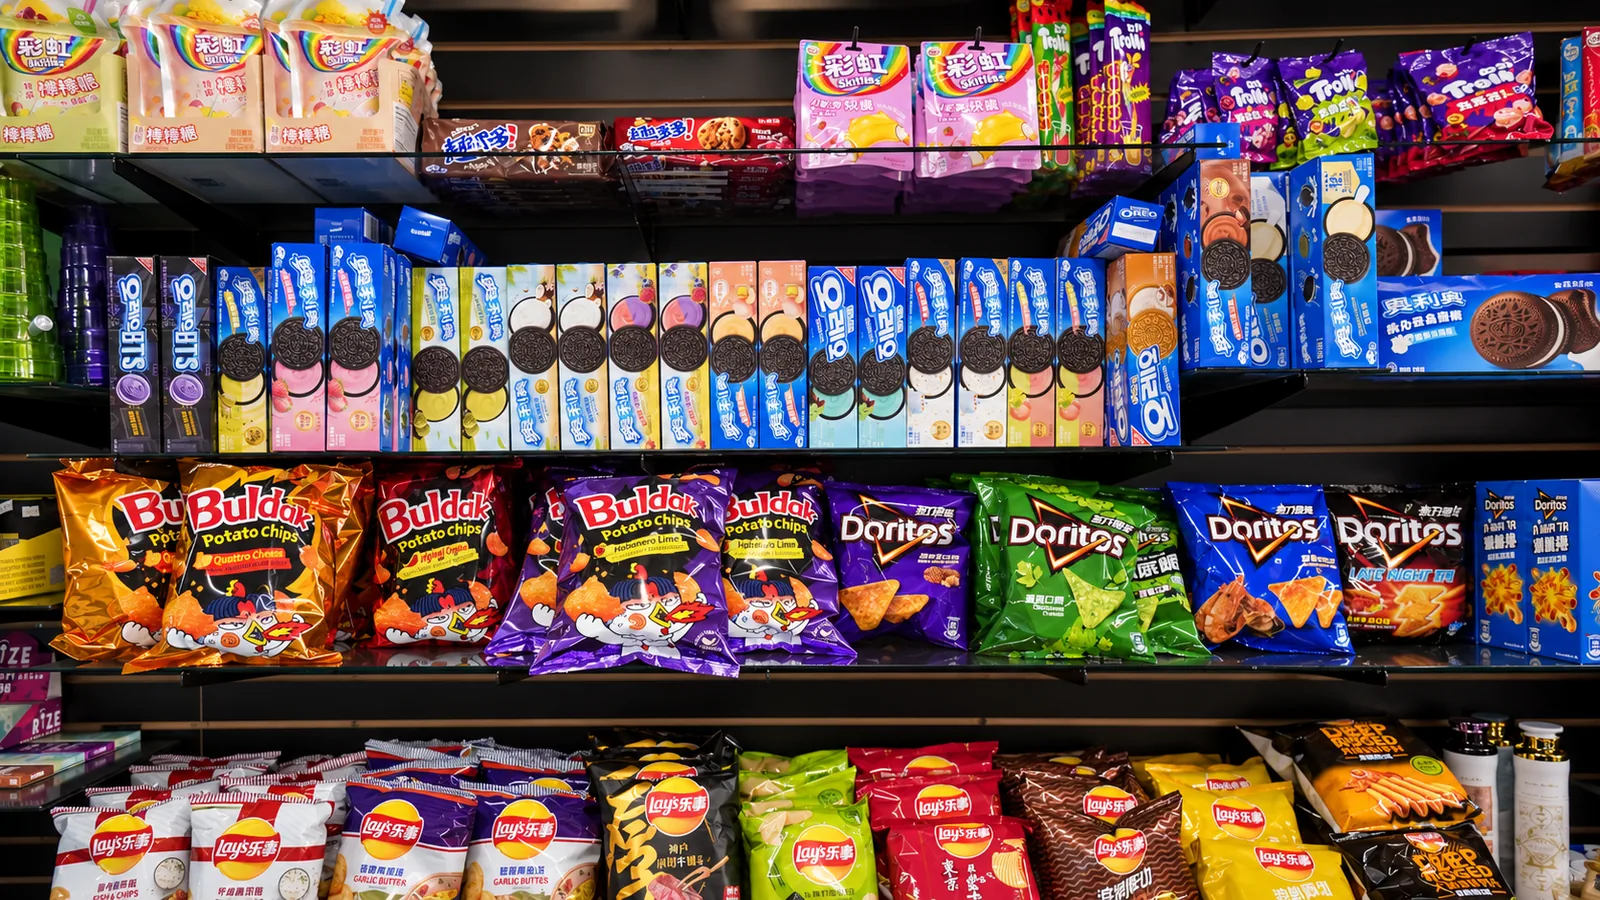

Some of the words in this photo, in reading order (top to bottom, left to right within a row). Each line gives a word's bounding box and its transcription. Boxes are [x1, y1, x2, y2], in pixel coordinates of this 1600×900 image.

[17, 37, 72, 58] 彩虹
[194, 34, 246, 55] 彩虹
[319, 40, 367, 56] 彩虹
[823, 53, 888, 78] 彩虹
[945, 52, 1012, 78] 彩虹
[187, 485, 314, 533] Buldak
[574, 484, 699, 530] Buldak
[1485, 499, 1515, 510] Doritos
[1535, 499, 1567, 511] Doritos
[378, 489, 491, 544] Buldak
[202, 527, 258, 548] Potato
[260, 524, 298, 544] Chips
[398, 529, 446, 553] Potato
[447, 522, 482, 537] Chips
[601, 519, 652, 541] Potato
[654, 514, 691, 527] Chips
[725, 519, 773, 537] Potato
[774, 519, 807, 534] Chips
[841, 515, 953, 545] Doritos
[1009, 518, 1126, 558] Doritos
[1208, 516, 1318, 540] Doritos
[1337, 516, 1462, 546] Doritos
[657, 535, 679, 544] Lime
[649, 795, 679, 816] Lay's
[679, 796, 707, 812] 乐事
[919, 799, 944, 817] Lay's
[1087, 798, 1113, 815] Lay's
[1216, 807, 1240, 823] Lay's
[362, 817, 392, 839] Lay's
[495, 821, 525, 840] Lay's
[524, 821, 554, 838] 乐事
[939, 827, 965, 841] Lay's
[93, 835, 121, 857] Lay's
[121, 832, 152, 851] 乐事
[215, 839, 247, 860] Lay's
[246, 840, 279, 857] 乐事
[796, 845, 826, 864] Lay's
[825, 845, 854, 860] 乐事
[1259, 850, 1286, 865] Lay's
[353, 875, 378, 886] GARLIC
[493, 877, 520, 886] GARLIC
